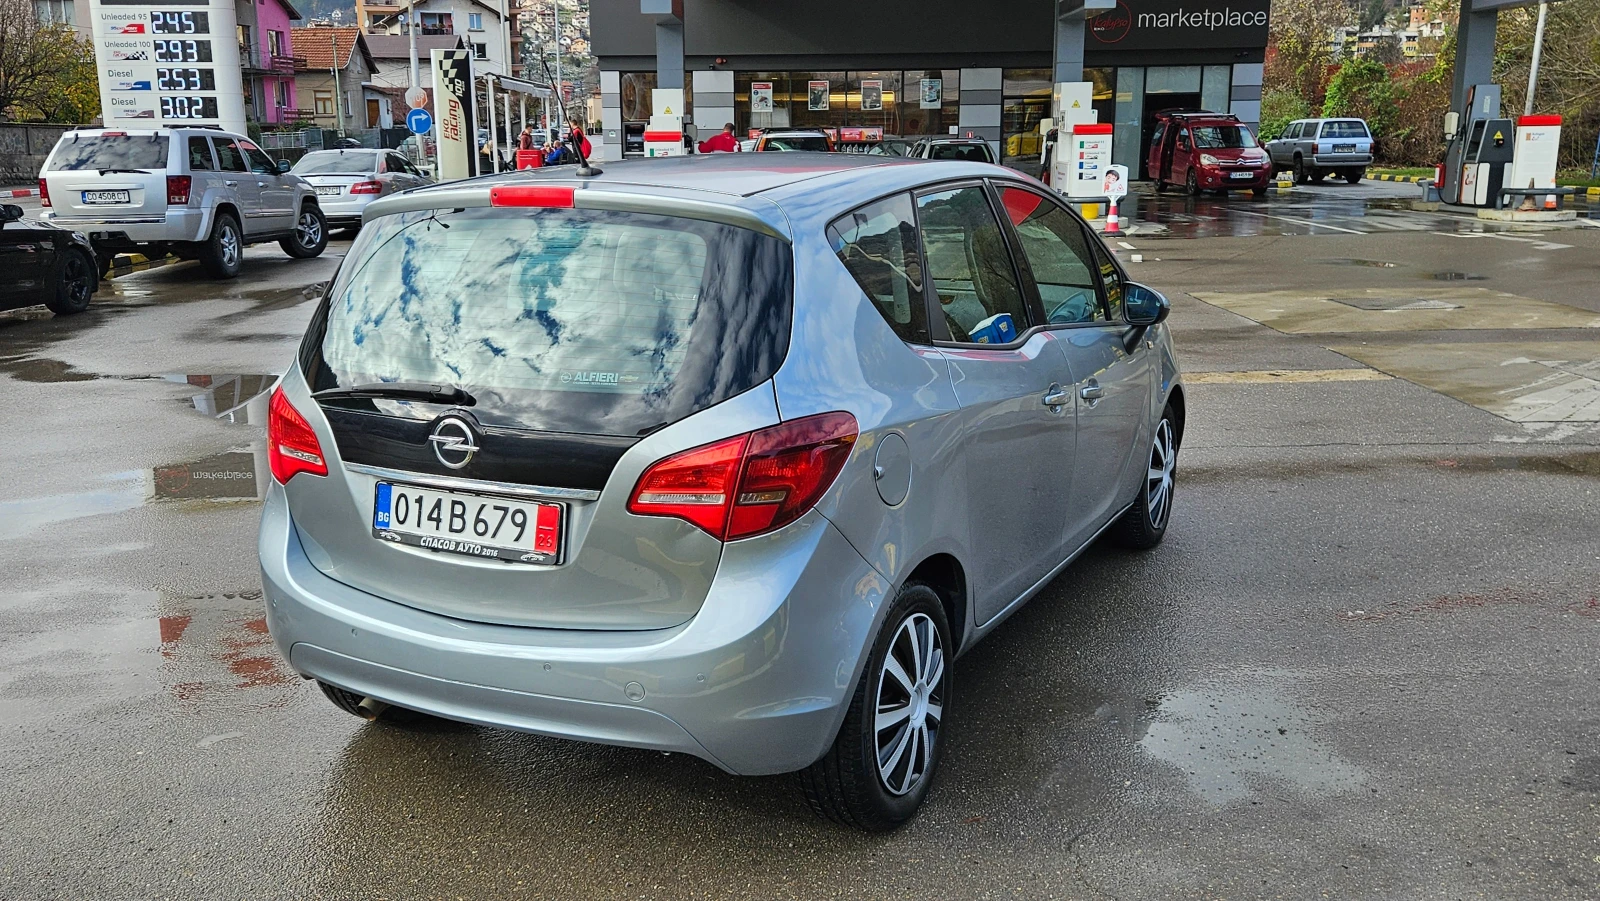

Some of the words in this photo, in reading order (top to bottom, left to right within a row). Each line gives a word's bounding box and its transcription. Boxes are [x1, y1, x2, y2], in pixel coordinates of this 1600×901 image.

[101, 13, 136, 21] Unleaded
[151, 11, 195, 34] 2.45
[1137, 7, 1267, 31] marketplace
[155, 40, 198, 62] 2.93
[107, 69, 133, 78] Diesel
[158, 68, 201, 90] 2.53
[454, 78, 464, 98] 100
[111, 98, 137, 106] Diesel
[161, 96, 203, 118] 3.02
[443, 118, 451, 139] EKO
[448, 98, 460, 142] racing
[117, 192, 127, 200] CT
[573, 371, 619, 383] ALFIERI
[377, 511, 390, 523] BG
[420, 536, 456, 551] СПАСОВ
[456, 542, 482, 555] АУТО
[482, 547, 499, 557] 2016
[538, 533, 553, 548] 26
